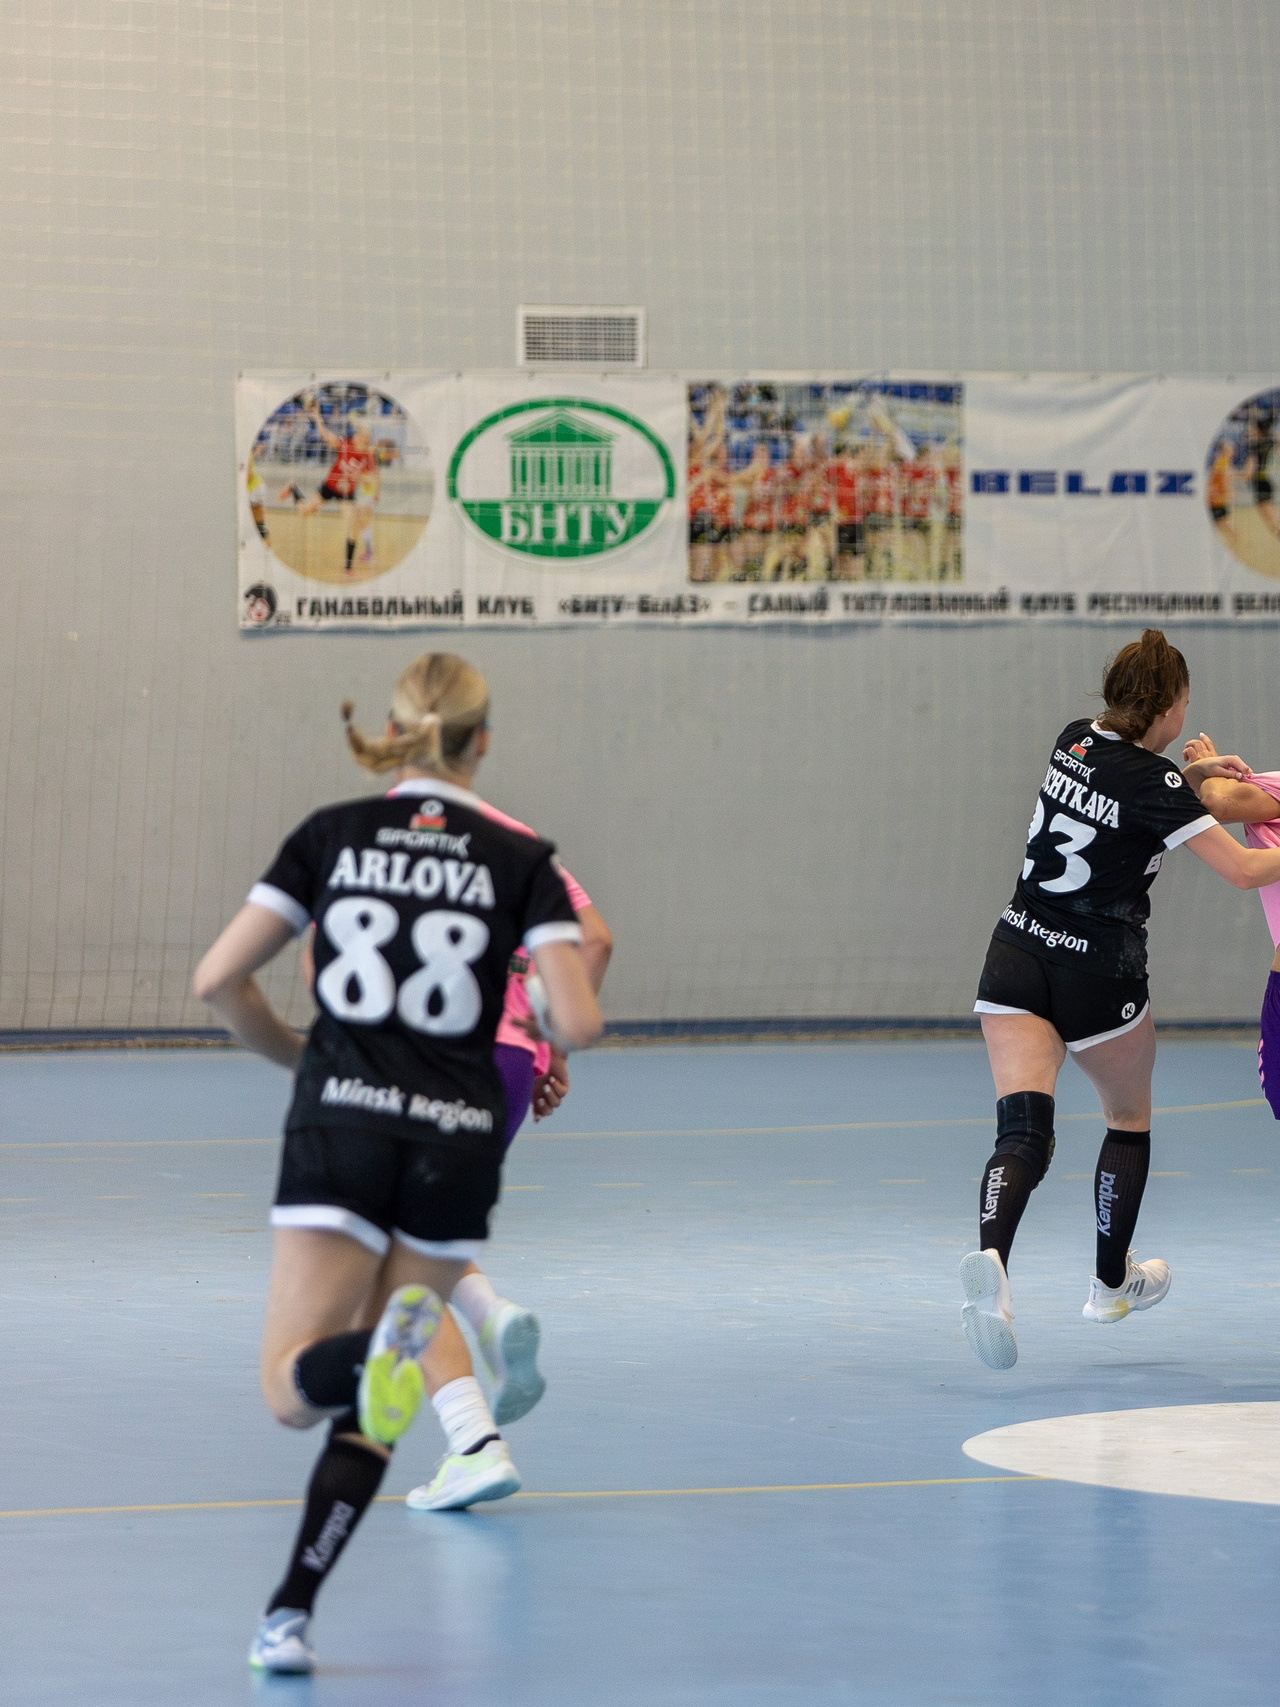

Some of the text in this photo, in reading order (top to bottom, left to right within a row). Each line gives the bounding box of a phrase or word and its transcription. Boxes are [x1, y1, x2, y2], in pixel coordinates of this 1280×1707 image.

[972, 470, 1196, 495] BELAZ
[502, 503, 636, 546] БНТУ
[295, 589, 465, 616] ГАНДБОЛЬНЫЙ
[477, 595, 535, 616] КЛУБ
[1053, 749, 1096, 784] SPORTIX
[327, 846, 496, 909] ARLOVA
[317, 895, 491, 1037] 88
[320, 1076, 494, 1133] Minsk Region
[980, 1166, 1008, 1224] Kempa
[1097, 1170, 1119, 1237] Kempa
